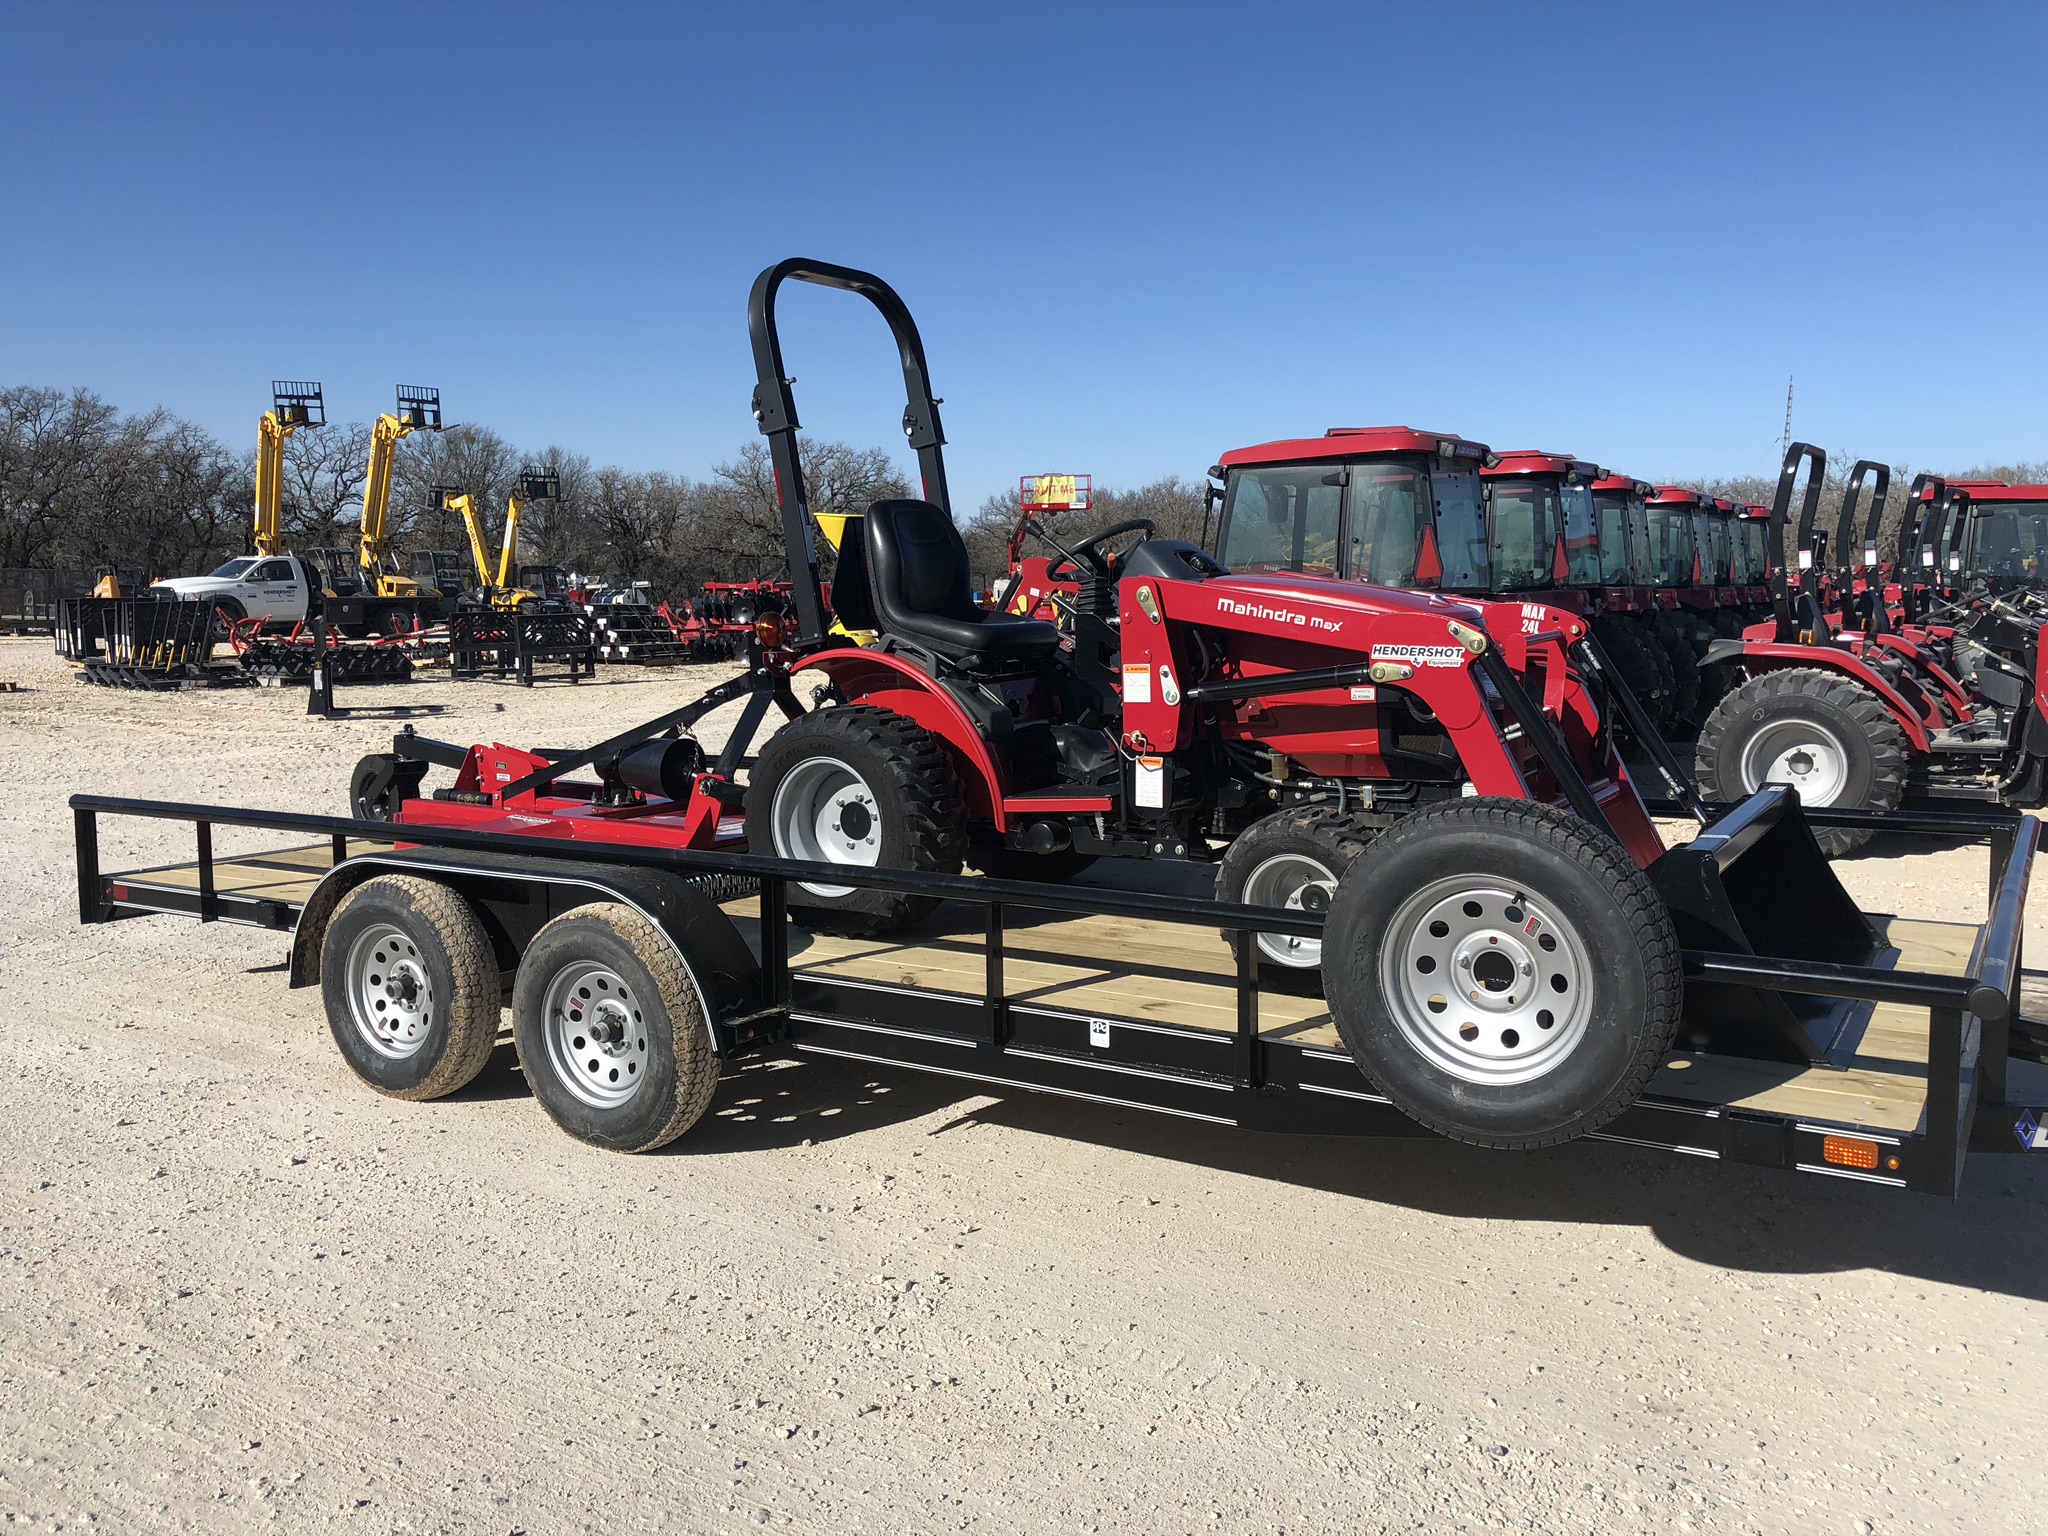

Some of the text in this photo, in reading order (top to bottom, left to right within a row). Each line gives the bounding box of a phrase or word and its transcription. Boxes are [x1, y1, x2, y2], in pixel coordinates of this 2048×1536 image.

[1521, 604, 1546, 621] MAX
[1521, 619, 1540, 634] 24L
[1373, 646, 1463, 658] HENDERSHOT
[1093, 1021, 1107, 1034] PPG
